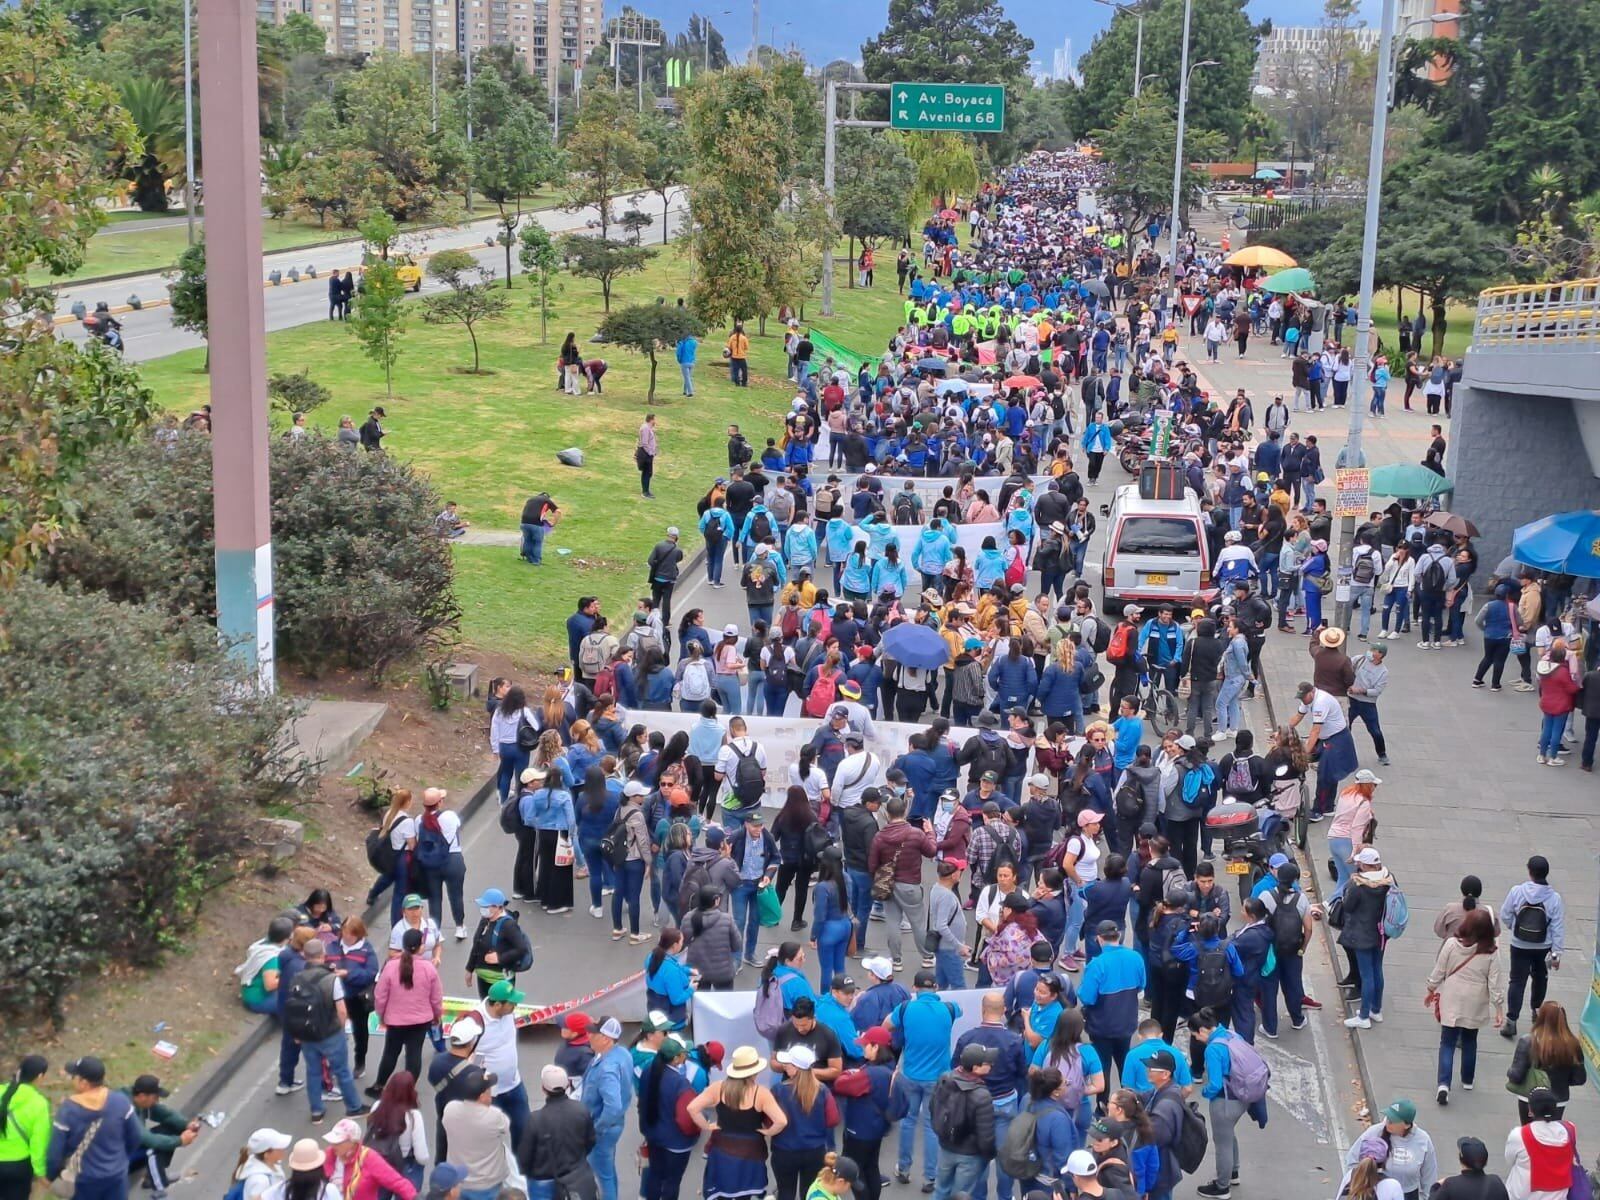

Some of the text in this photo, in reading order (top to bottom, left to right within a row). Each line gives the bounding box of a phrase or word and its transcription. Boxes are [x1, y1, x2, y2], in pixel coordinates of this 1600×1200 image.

[919, 92, 993, 108] Av. Boyacá
[918, 110, 995, 124] Avenida 68
